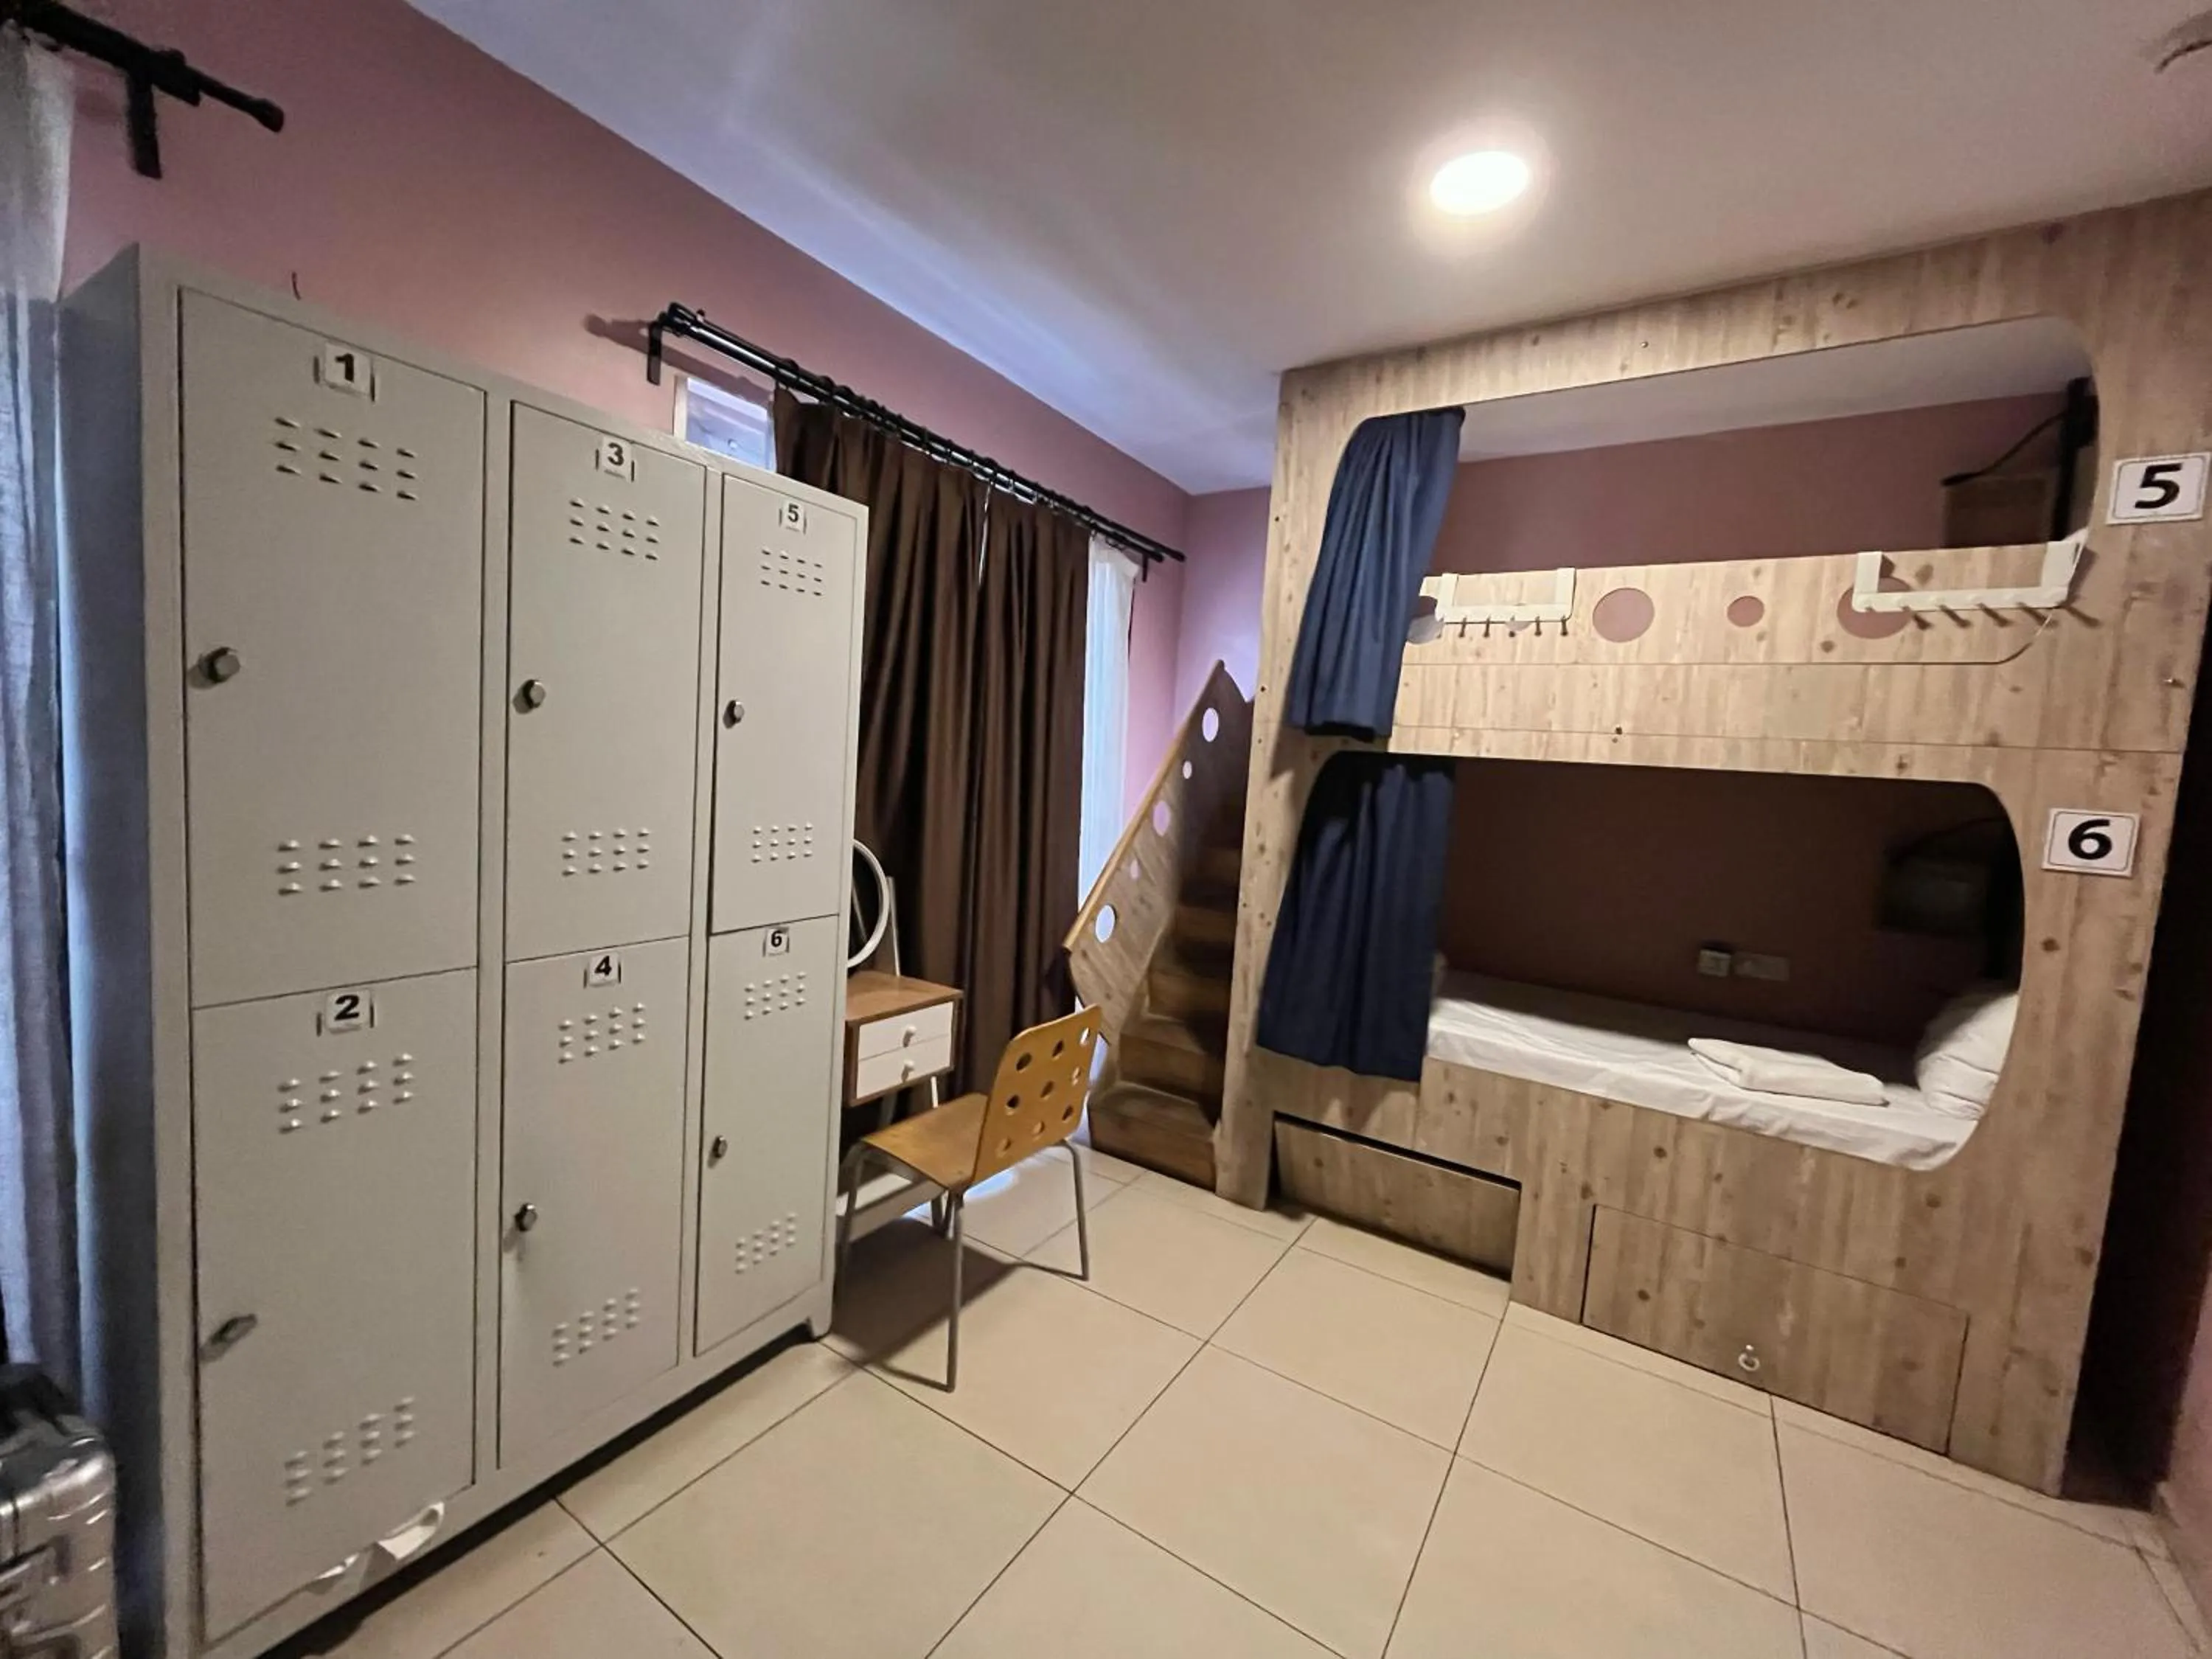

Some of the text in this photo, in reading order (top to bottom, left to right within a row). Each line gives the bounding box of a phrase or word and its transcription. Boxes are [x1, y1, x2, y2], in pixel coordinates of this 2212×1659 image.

[335, 353, 355, 382] 1
[607, 442, 625, 466] 3
[2135, 463, 2183, 509] 5
[787, 503, 799, 522] 5
[2068, 818, 2113, 860] 6
[771, 931, 783, 947] 6
[594, 956, 612, 975] 4
[334, 994, 360, 1020] 2
